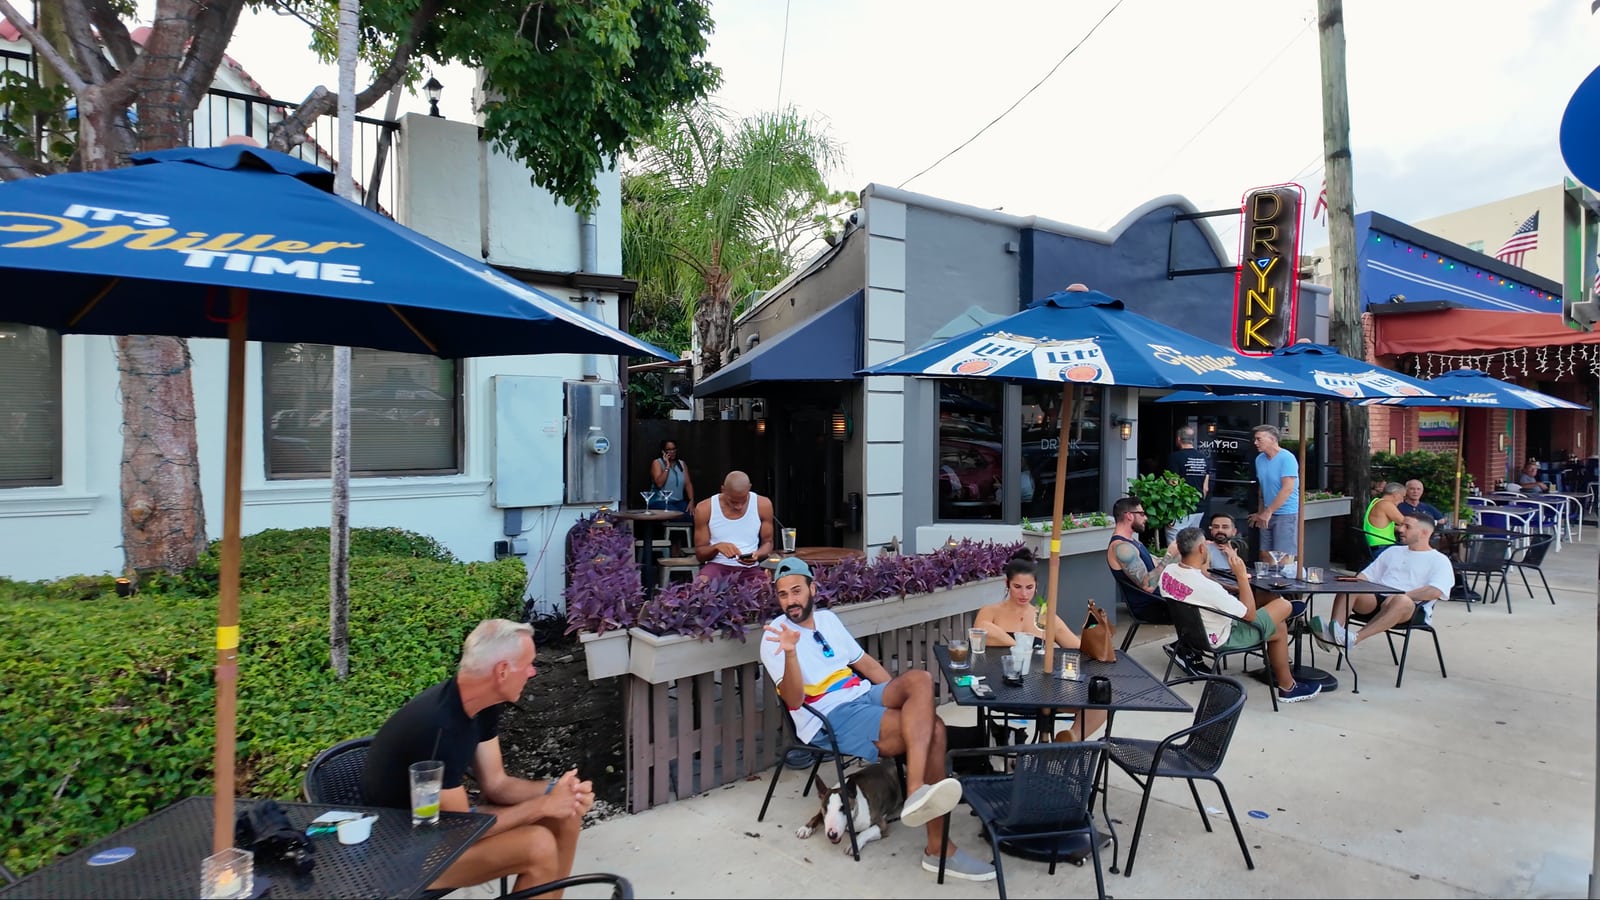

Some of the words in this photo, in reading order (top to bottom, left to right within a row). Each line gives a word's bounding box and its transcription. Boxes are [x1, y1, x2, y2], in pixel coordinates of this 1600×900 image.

[63, 204, 170, 226] IT'S
[0, 211, 365, 253] Miller
[1243, 192, 1281, 347] DRYNK
[972, 342, 1028, 357] Lite
[1046, 348, 1099, 364] Lite
[1153, 351, 1237, 375] Miller
[1041, 436, 1080, 450] DRNK
